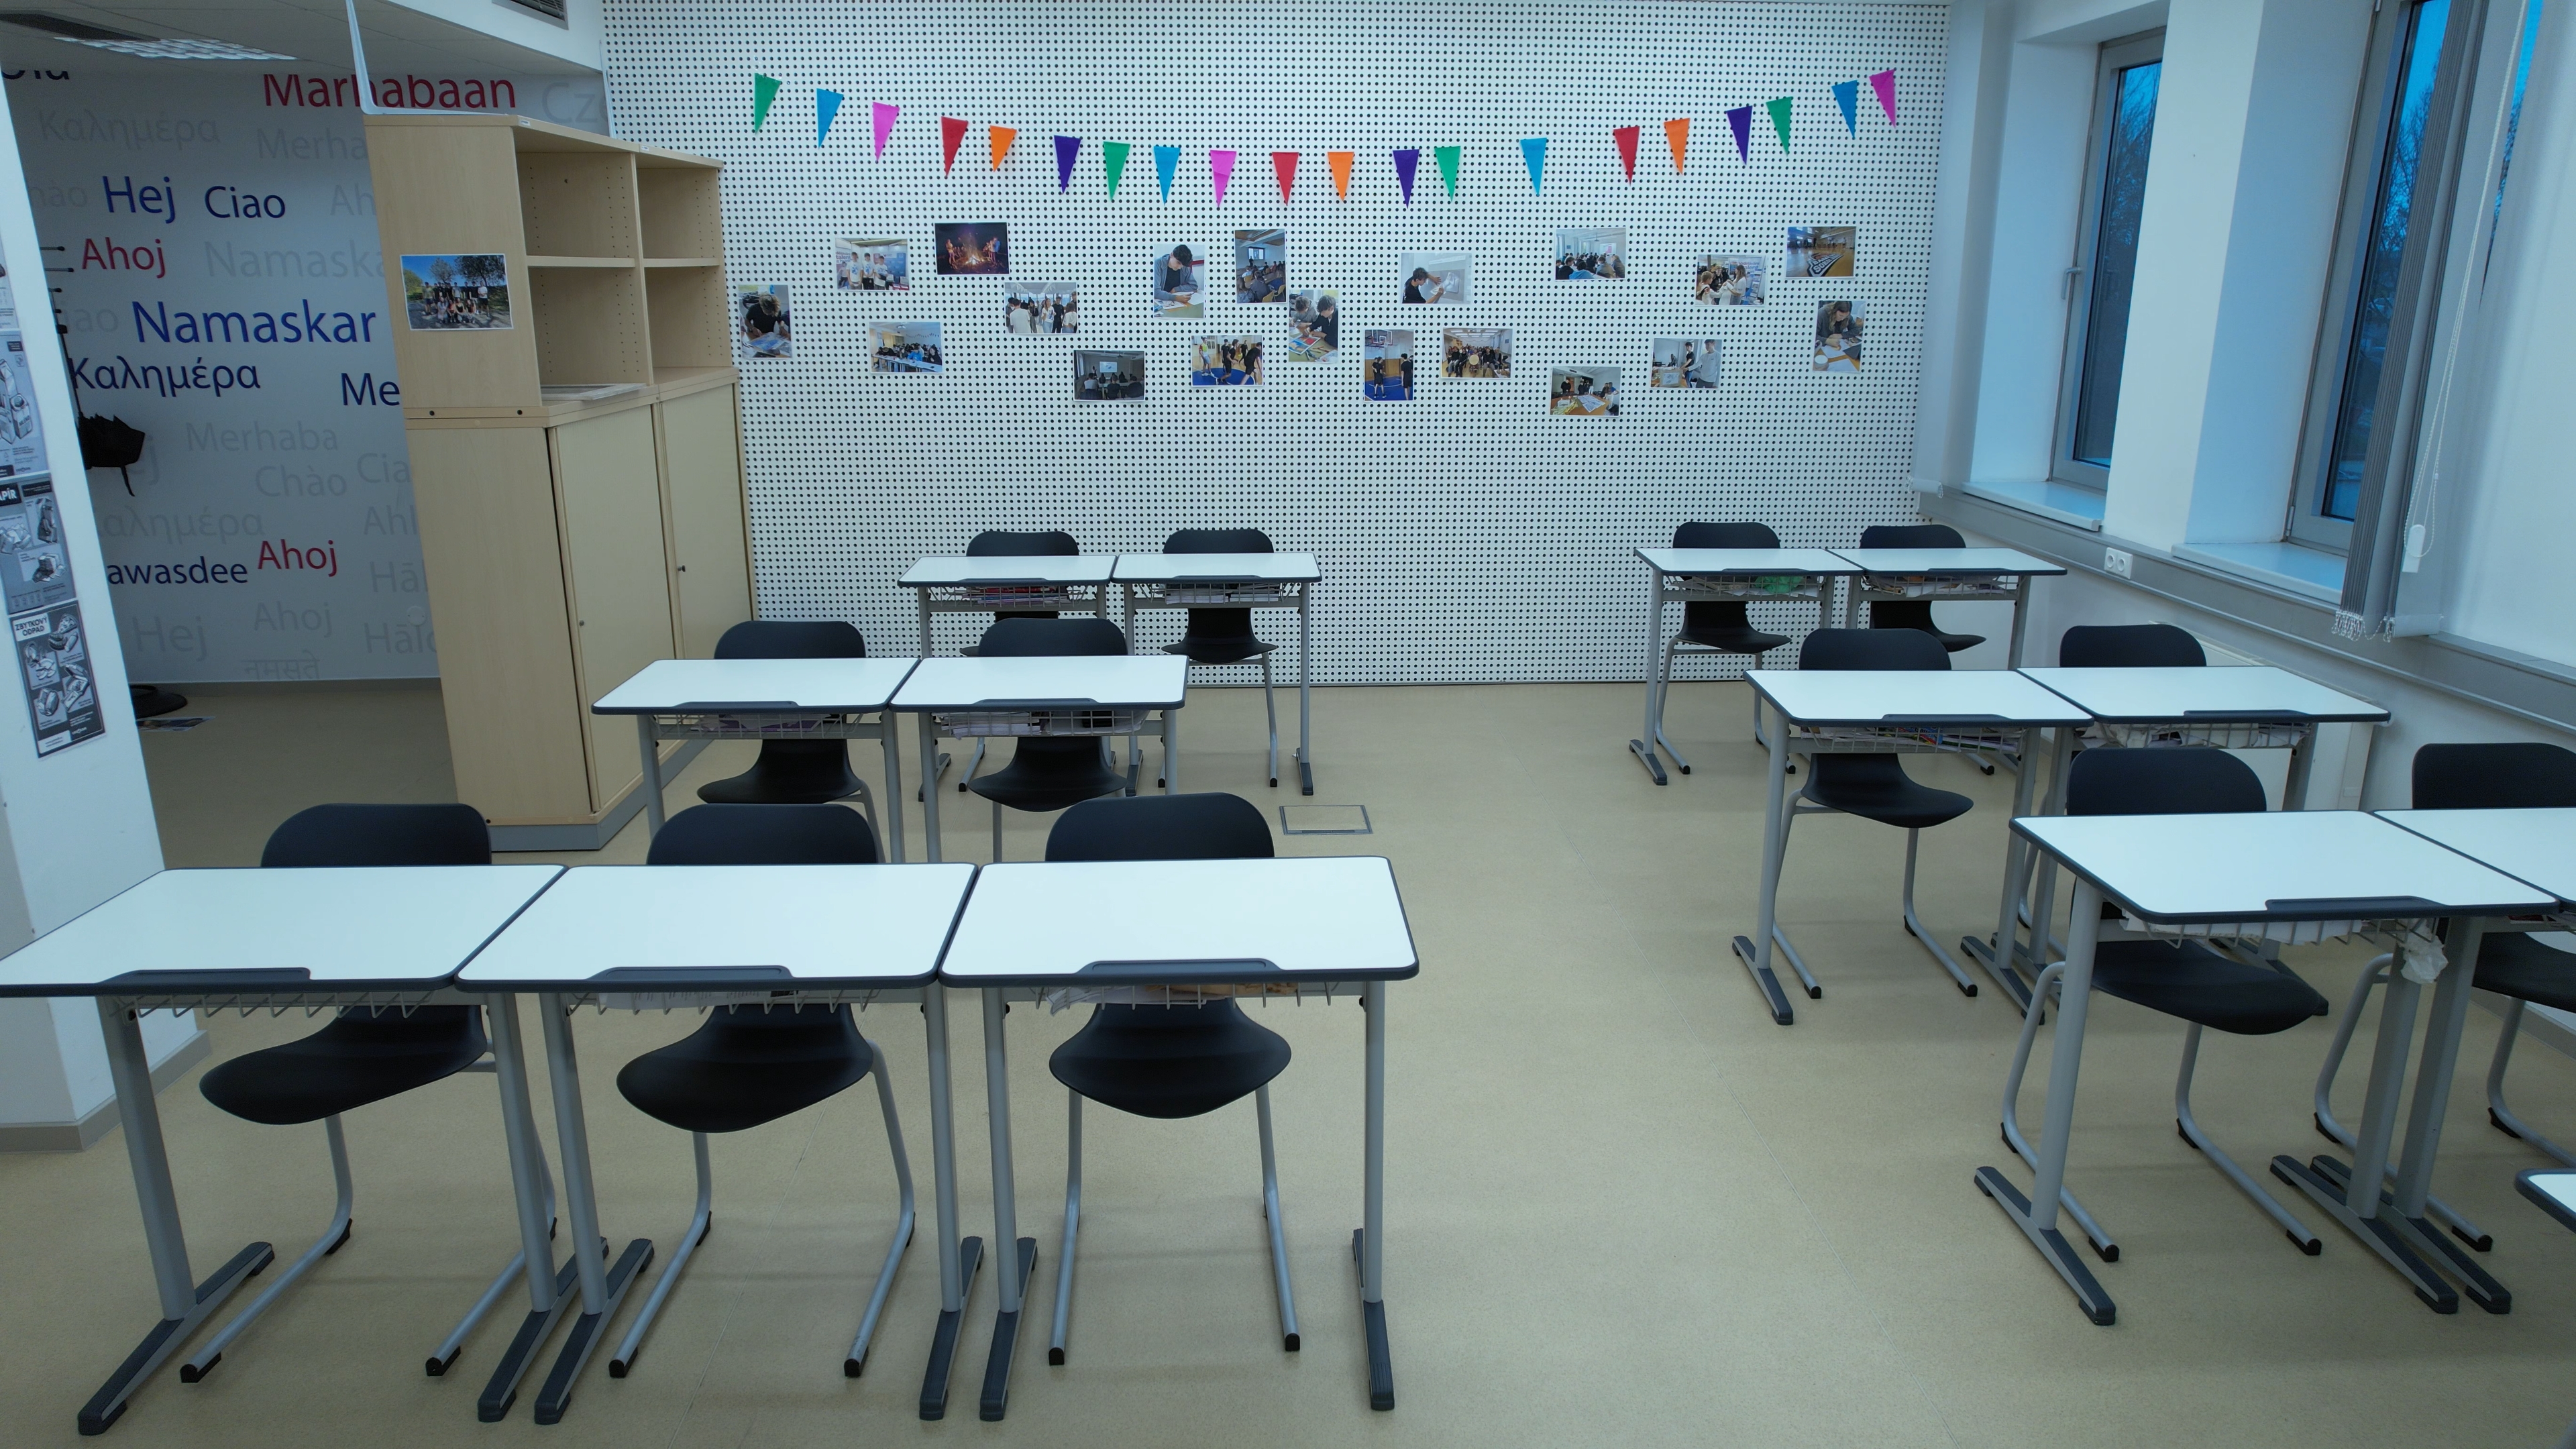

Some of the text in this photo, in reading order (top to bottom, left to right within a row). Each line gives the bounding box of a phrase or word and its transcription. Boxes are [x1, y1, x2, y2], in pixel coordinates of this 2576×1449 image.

[263, 74, 516, 109] Marhabaan
[103, 176, 176, 224] Hej
[205, 186, 286, 219] Ciao
[82, 237, 166, 278] Ahoj
[132, 299, 376, 343] Namaskar
[68, 355, 261, 397] Καλημέρα
[341, 373, 400, 407] Me
[186, 421, 339, 451] Merhaba
[256, 465, 347, 497] Chào
[94, 505, 264, 545] αλημέρα
[107, 556, 248, 585] awasdee
[258, 539, 337, 578] Ahoj
[22, 625, 45, 637] ODPAD
[133, 616, 208, 662] Hej
[254, 601, 332, 639] Ahoj
